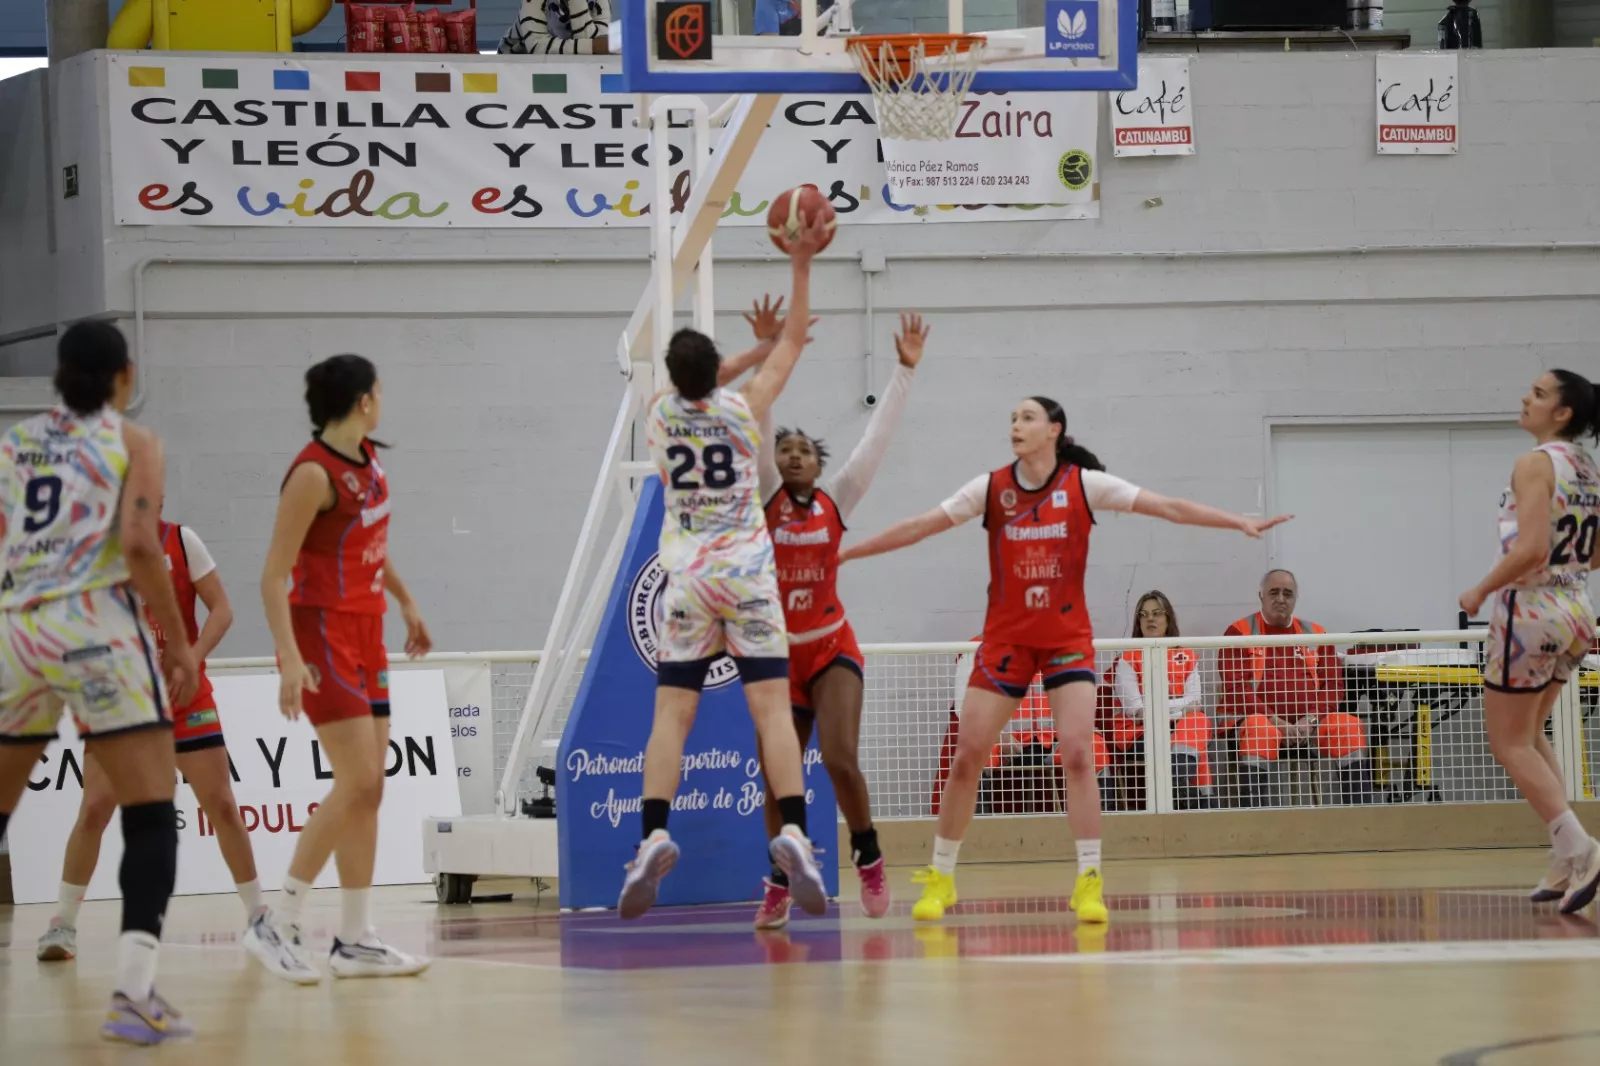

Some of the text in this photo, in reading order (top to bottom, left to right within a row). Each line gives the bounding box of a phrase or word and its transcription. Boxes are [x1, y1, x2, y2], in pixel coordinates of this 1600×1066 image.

[130, 97, 451, 129] CASTILLA
[1116, 80, 1185, 124] Café
[1382, 78, 1453, 122] Café
[954, 100, 1054, 138] Zaira
[160, 132, 417, 167] Y LEÓN
[492, 142, 536, 169] Y
[810, 138, 853, 164] Y
[919, 160, 943, 173] Páez
[946, 160, 979, 173] Ramos
[138, 168, 449, 220] es vida
[899, 179, 904, 189] y
[906, 176, 924, 187] Fax:
[925, 176, 941, 187] 987
[942, 176, 957, 187] 513
[959, 176, 975, 186] 224
[981, 175, 996, 186] 620
[997, 175, 1013, 186] 234
[1014, 175, 1030, 186] 243
[471, 184, 543, 219] es
[666, 444, 737, 490] 28
[23, 475, 63, 534] 9
[1548, 514, 1599, 566] 20
[449, 704, 480, 718] rada
[451, 724, 477, 738] elos
[255, 736, 288, 788] Y
[566, 748, 646, 782] Patronat
[680, 746, 742, 782] eportivo
[712, 786, 734, 809] de
